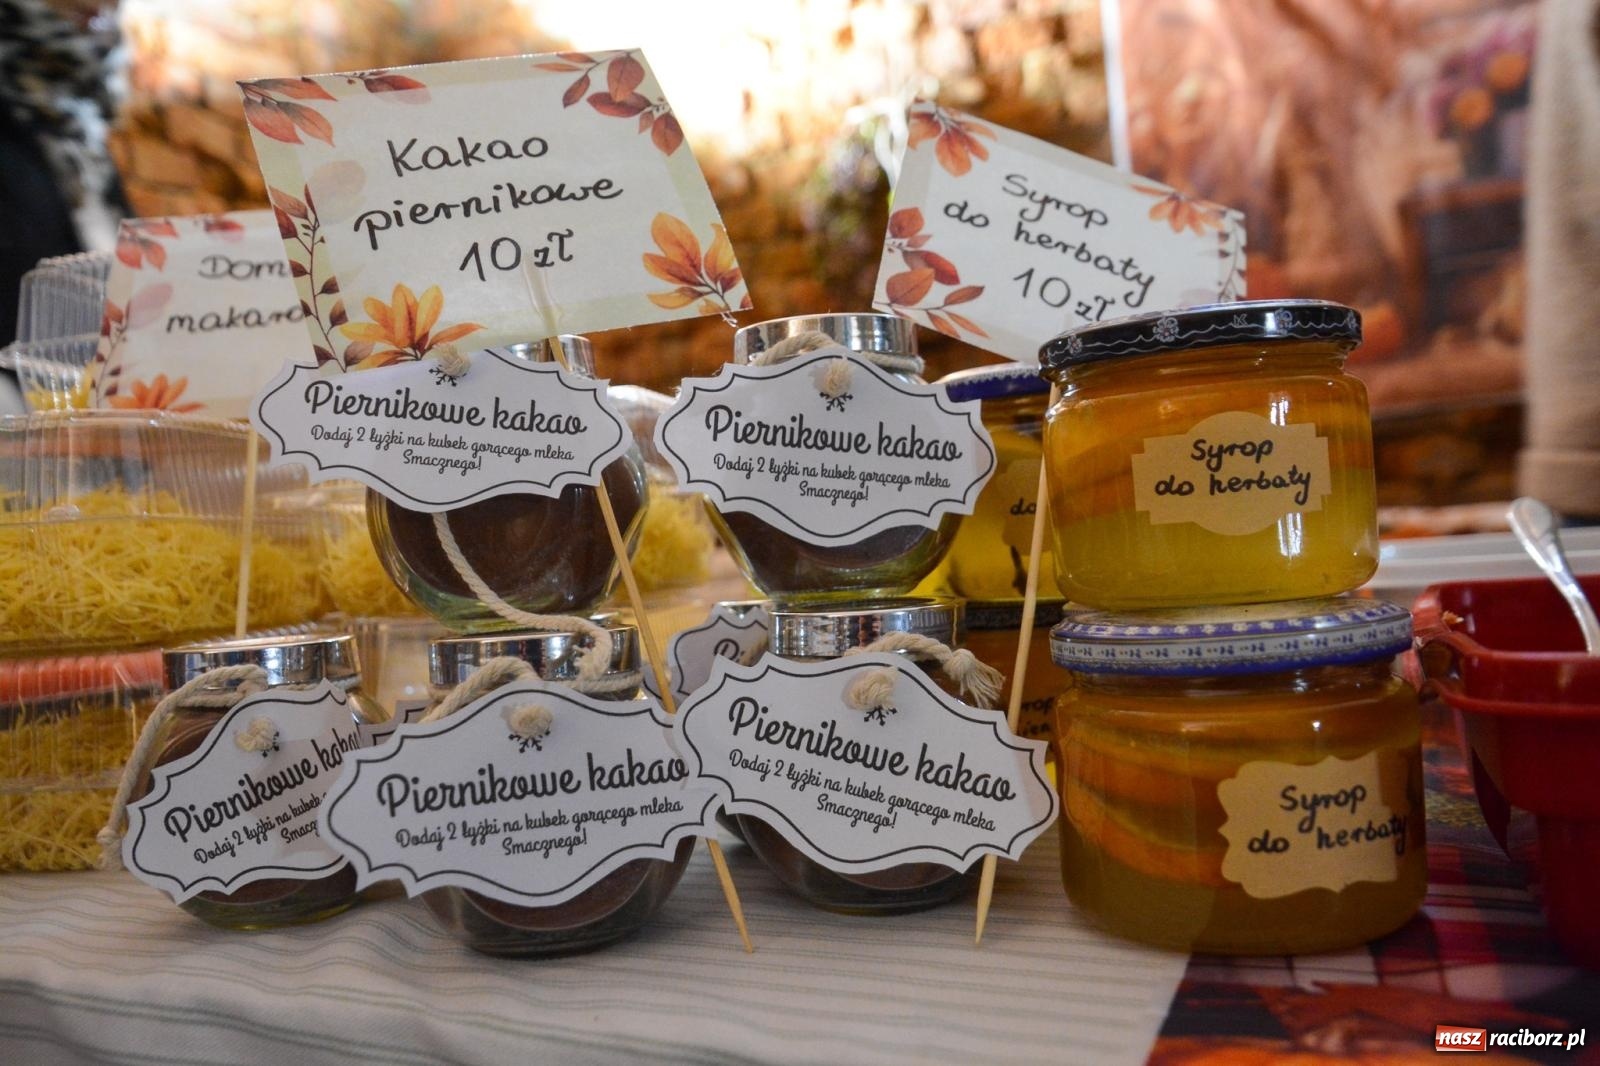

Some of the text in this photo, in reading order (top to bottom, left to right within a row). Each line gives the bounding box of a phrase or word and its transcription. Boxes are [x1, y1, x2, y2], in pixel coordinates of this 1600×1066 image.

[386, 136, 549, 177] Kakao
[353, 177, 623, 250] piernikowe
[1002, 173, 1108, 228] Syrop
[198, 254, 287, 280] Dom
[459, 236, 521, 282] 10
[944, 201, 1155, 308] do herbaty
[1013, 267, 1072, 308] 10
[166, 304, 306, 334] makaro
[304, 380, 587, 435] Piernikowe kakao
[311, 424, 574, 463] Dodaj 2 łyżki na kubek gorącego mleka
[705, 404, 962, 461] Piernikowe kakao
[402, 449, 482, 476] Smacznego!
[713, 453, 950, 491] Dodaj 2 łyżki na kubek gorącego mleka
[1190, 438, 1274, 473] Syrop
[799, 481, 869, 507] Smacznego!
[1154, 464, 1311, 506] do herbaty
[728, 696, 1016, 802] Piernikowe kakao
[164, 757, 318, 843] Piernikowe
[377, 746, 690, 818] Piernikowe kakao
[729, 748, 996, 832] Dodaj 2 łyżki na kubek gorącego mleka
[395, 798, 684, 849] Dodaj 2 łyżki na kubek gorącego mleka
[816, 794, 897, 835] Smacznego!
[1279, 784, 1367, 833] Syrop
[194, 837, 236, 864] Dodaj
[233, 831, 245, 846] 2
[275, 811, 292, 828] na
[502, 828, 588, 859] Smacznego!
[1247, 814, 1408, 856] do herbaty
